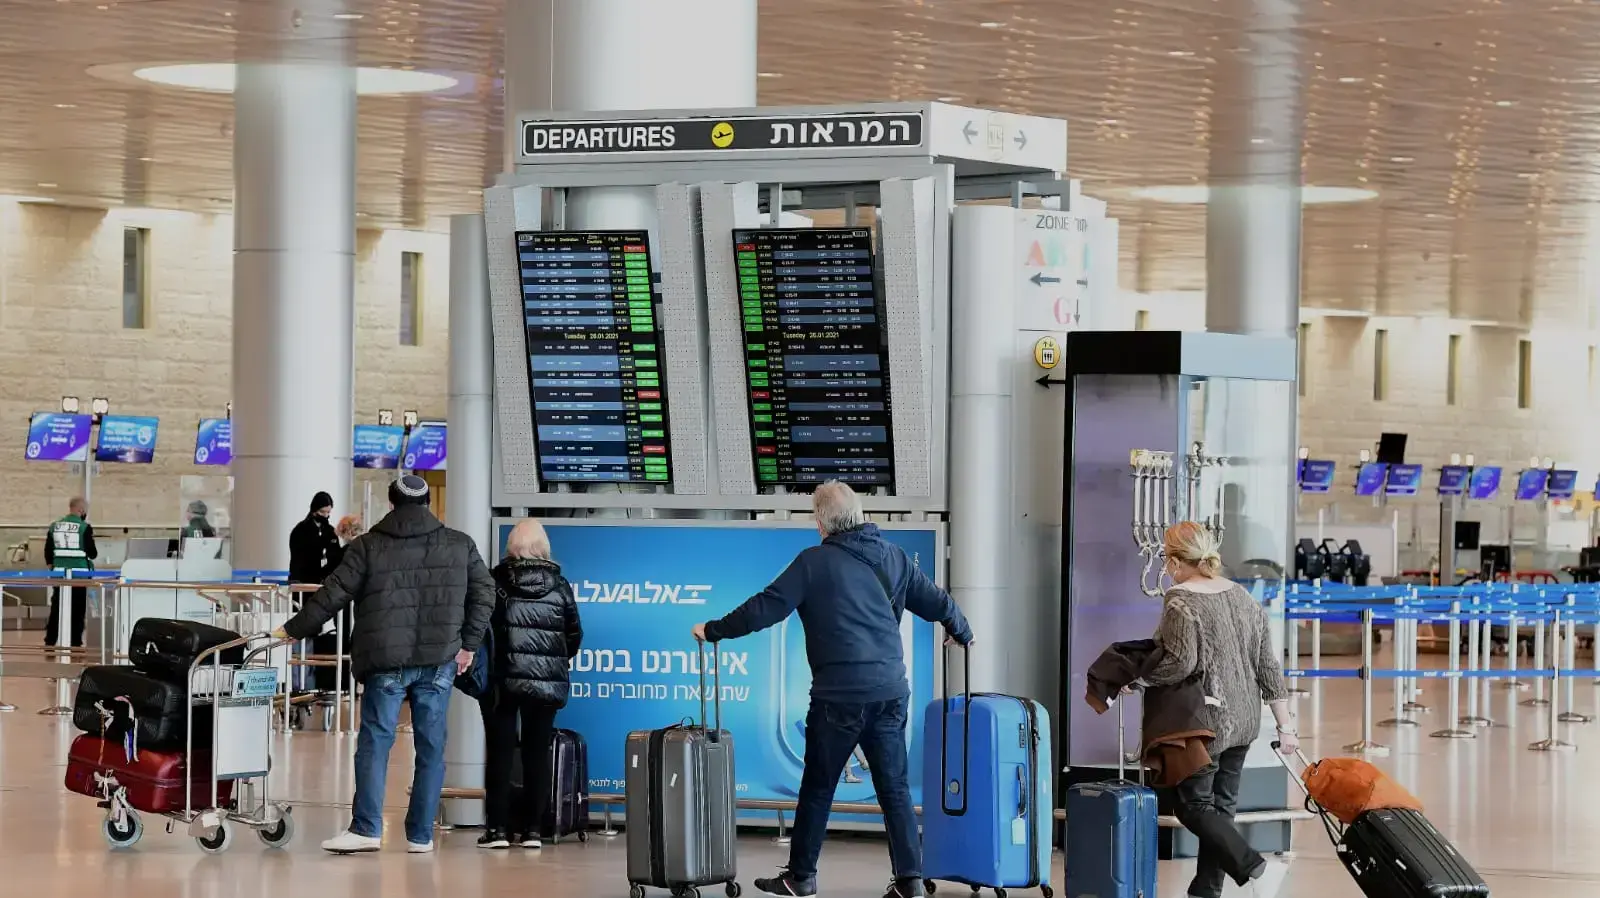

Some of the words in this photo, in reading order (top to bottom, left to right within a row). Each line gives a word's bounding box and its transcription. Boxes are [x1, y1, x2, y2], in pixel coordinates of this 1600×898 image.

[533, 125, 675, 149] DEPARTURES
[770, 120, 910, 144] המראות
[1036, 214, 1069, 231] ZONE
[1054, 297, 1071, 325] G
[571, 682, 591, 698] גם
[597, 683, 667, 700] מחוברים
